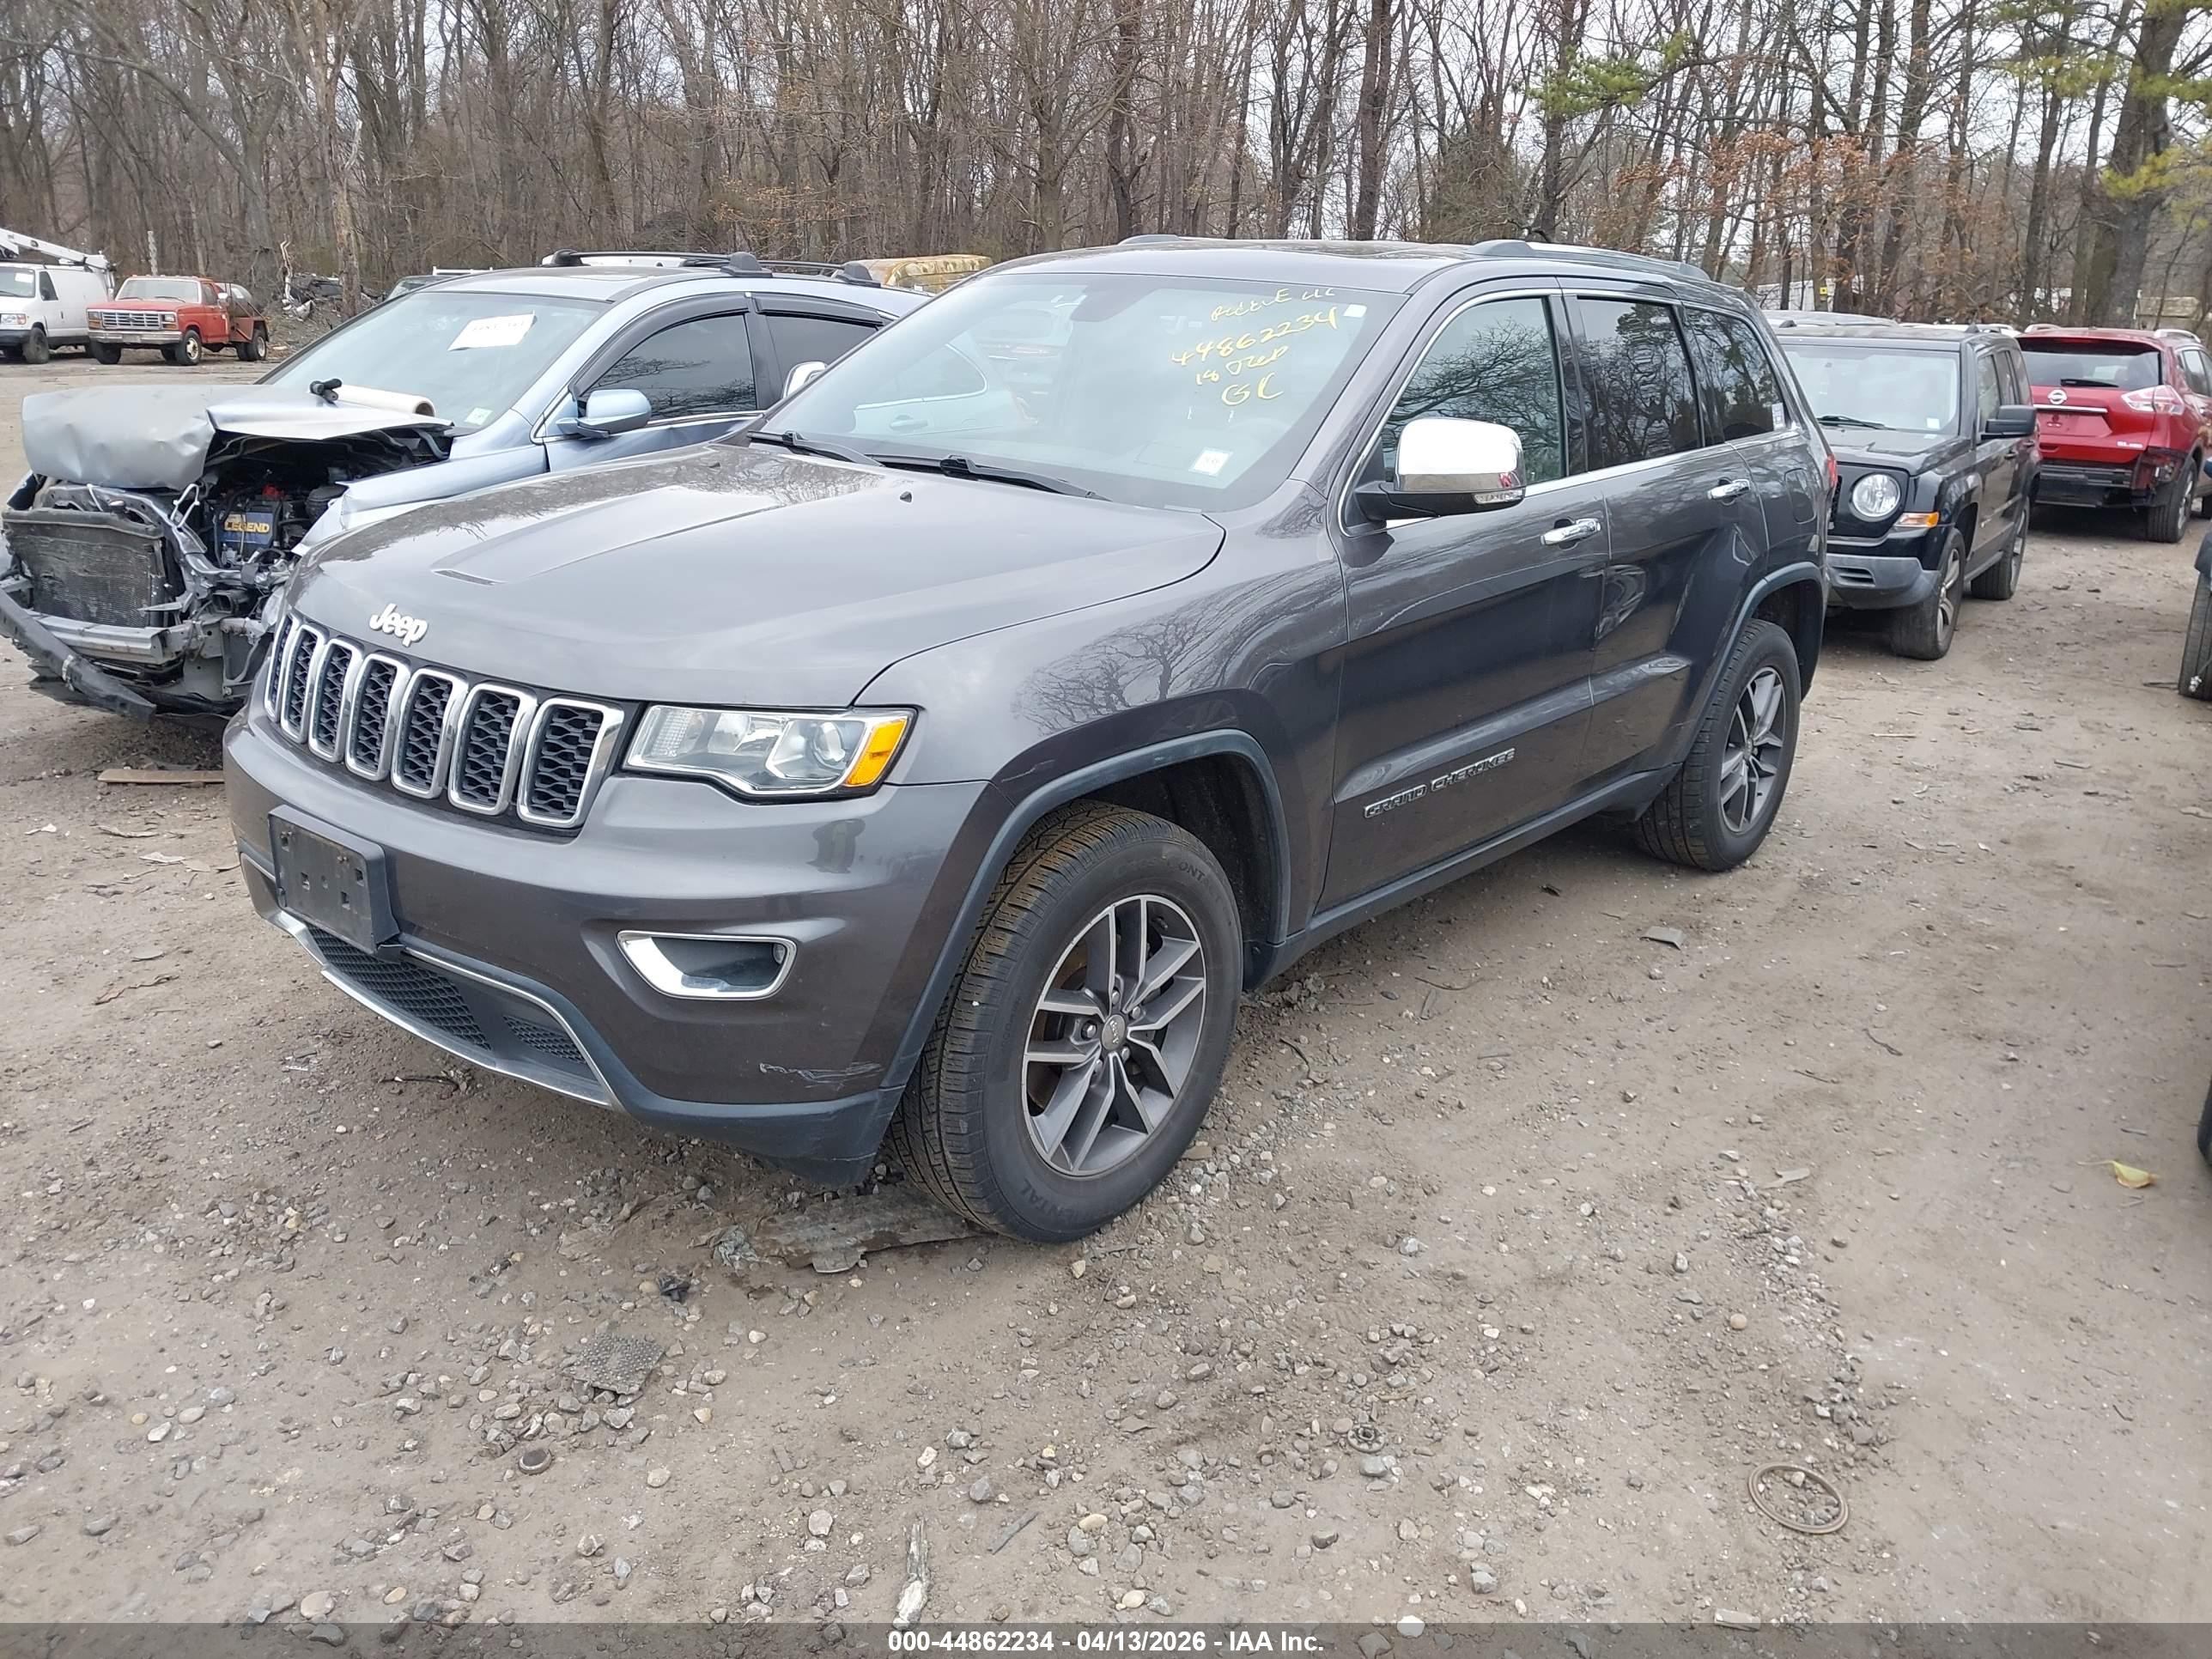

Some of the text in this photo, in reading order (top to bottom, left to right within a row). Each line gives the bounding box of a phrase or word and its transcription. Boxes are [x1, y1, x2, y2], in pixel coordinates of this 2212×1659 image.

[1171, 306, 1338, 365] 44862234
[369, 603, 428, 647] Jeep
[1364, 747, 1516, 818] GRAND CHEROKEE
